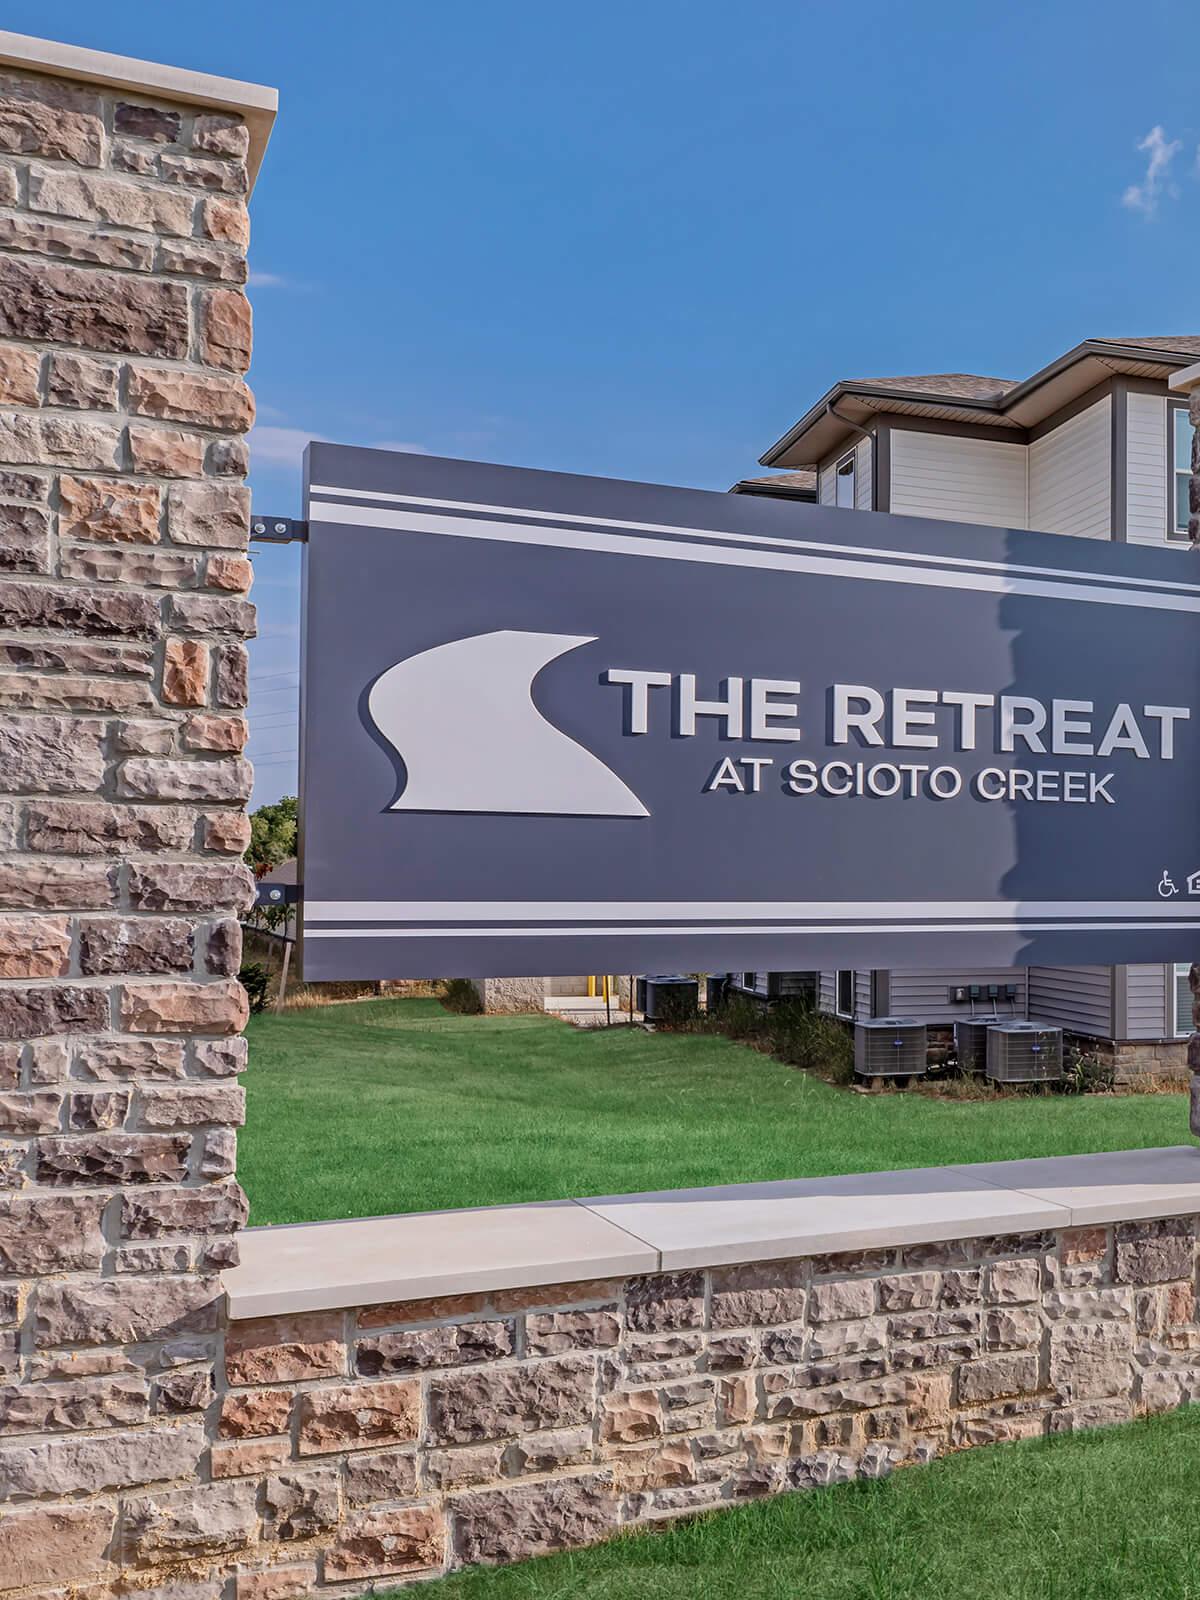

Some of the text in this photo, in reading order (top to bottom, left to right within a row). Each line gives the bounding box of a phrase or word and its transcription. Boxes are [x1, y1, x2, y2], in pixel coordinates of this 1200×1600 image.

[607, 669, 1191, 761] THE RETREAT
[709, 757, 1116, 804] AT SCIOTO CREEK
